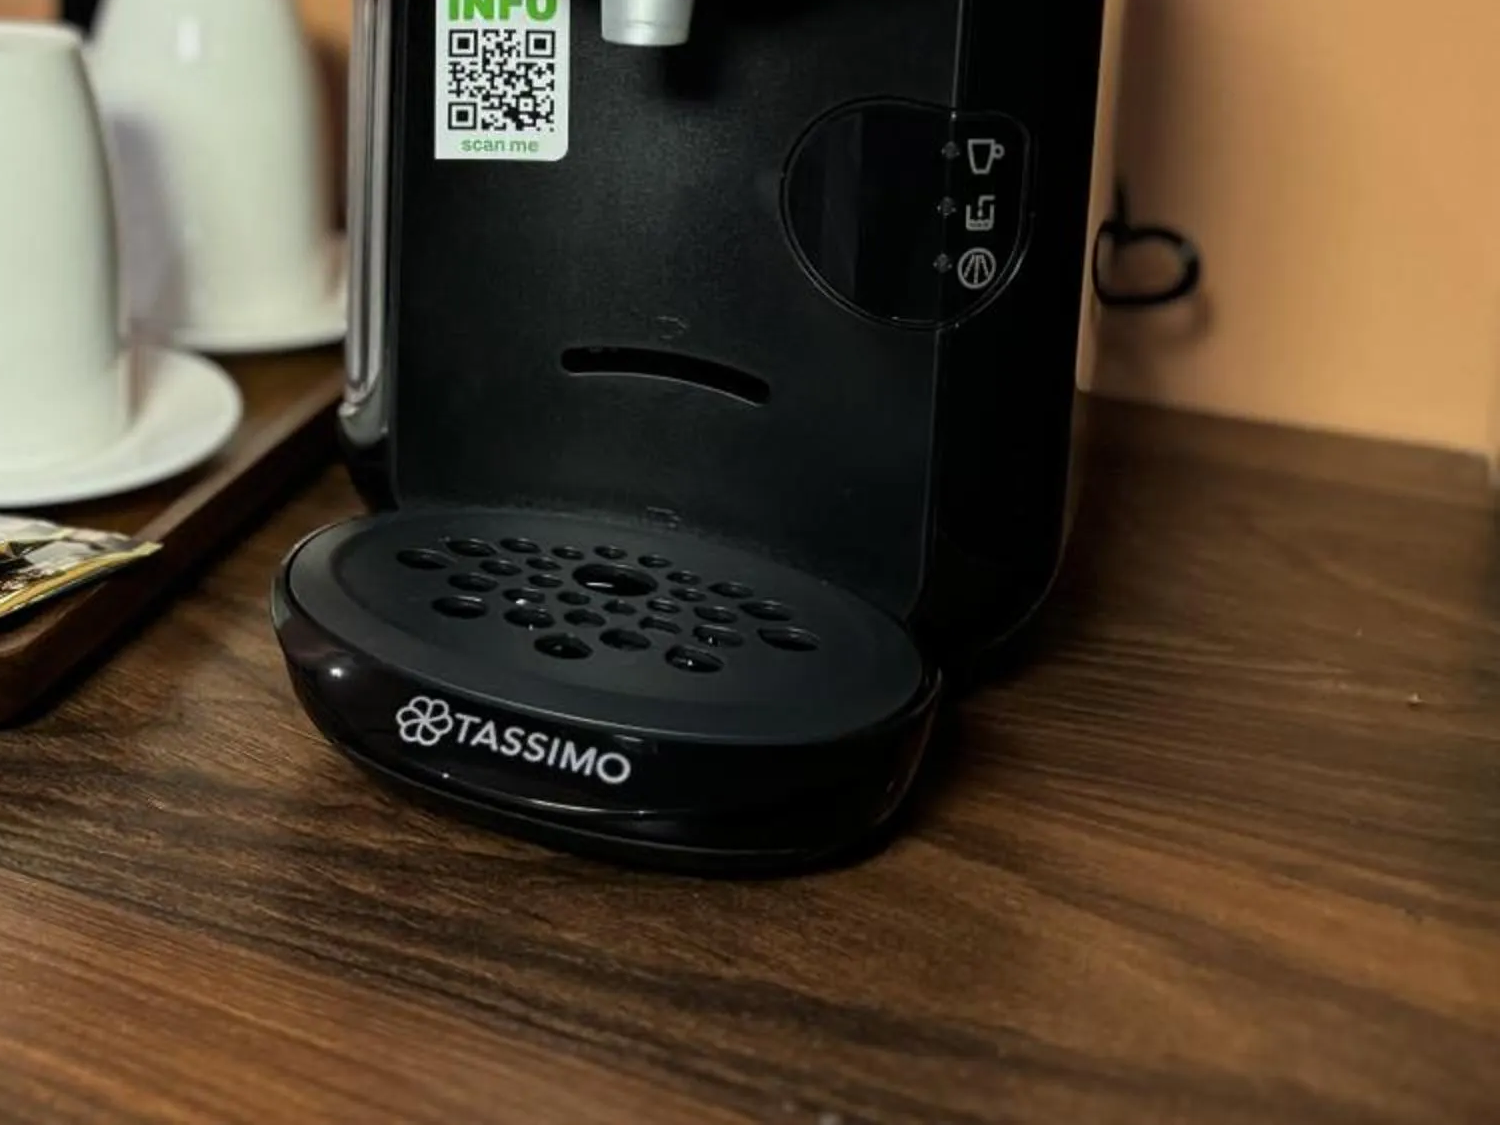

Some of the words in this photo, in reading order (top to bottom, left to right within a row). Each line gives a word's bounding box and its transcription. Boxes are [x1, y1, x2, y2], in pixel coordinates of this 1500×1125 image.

[461, 138, 505, 152] scan
[509, 139, 539, 153] me
[455, 713, 631, 784] TASSIMO
